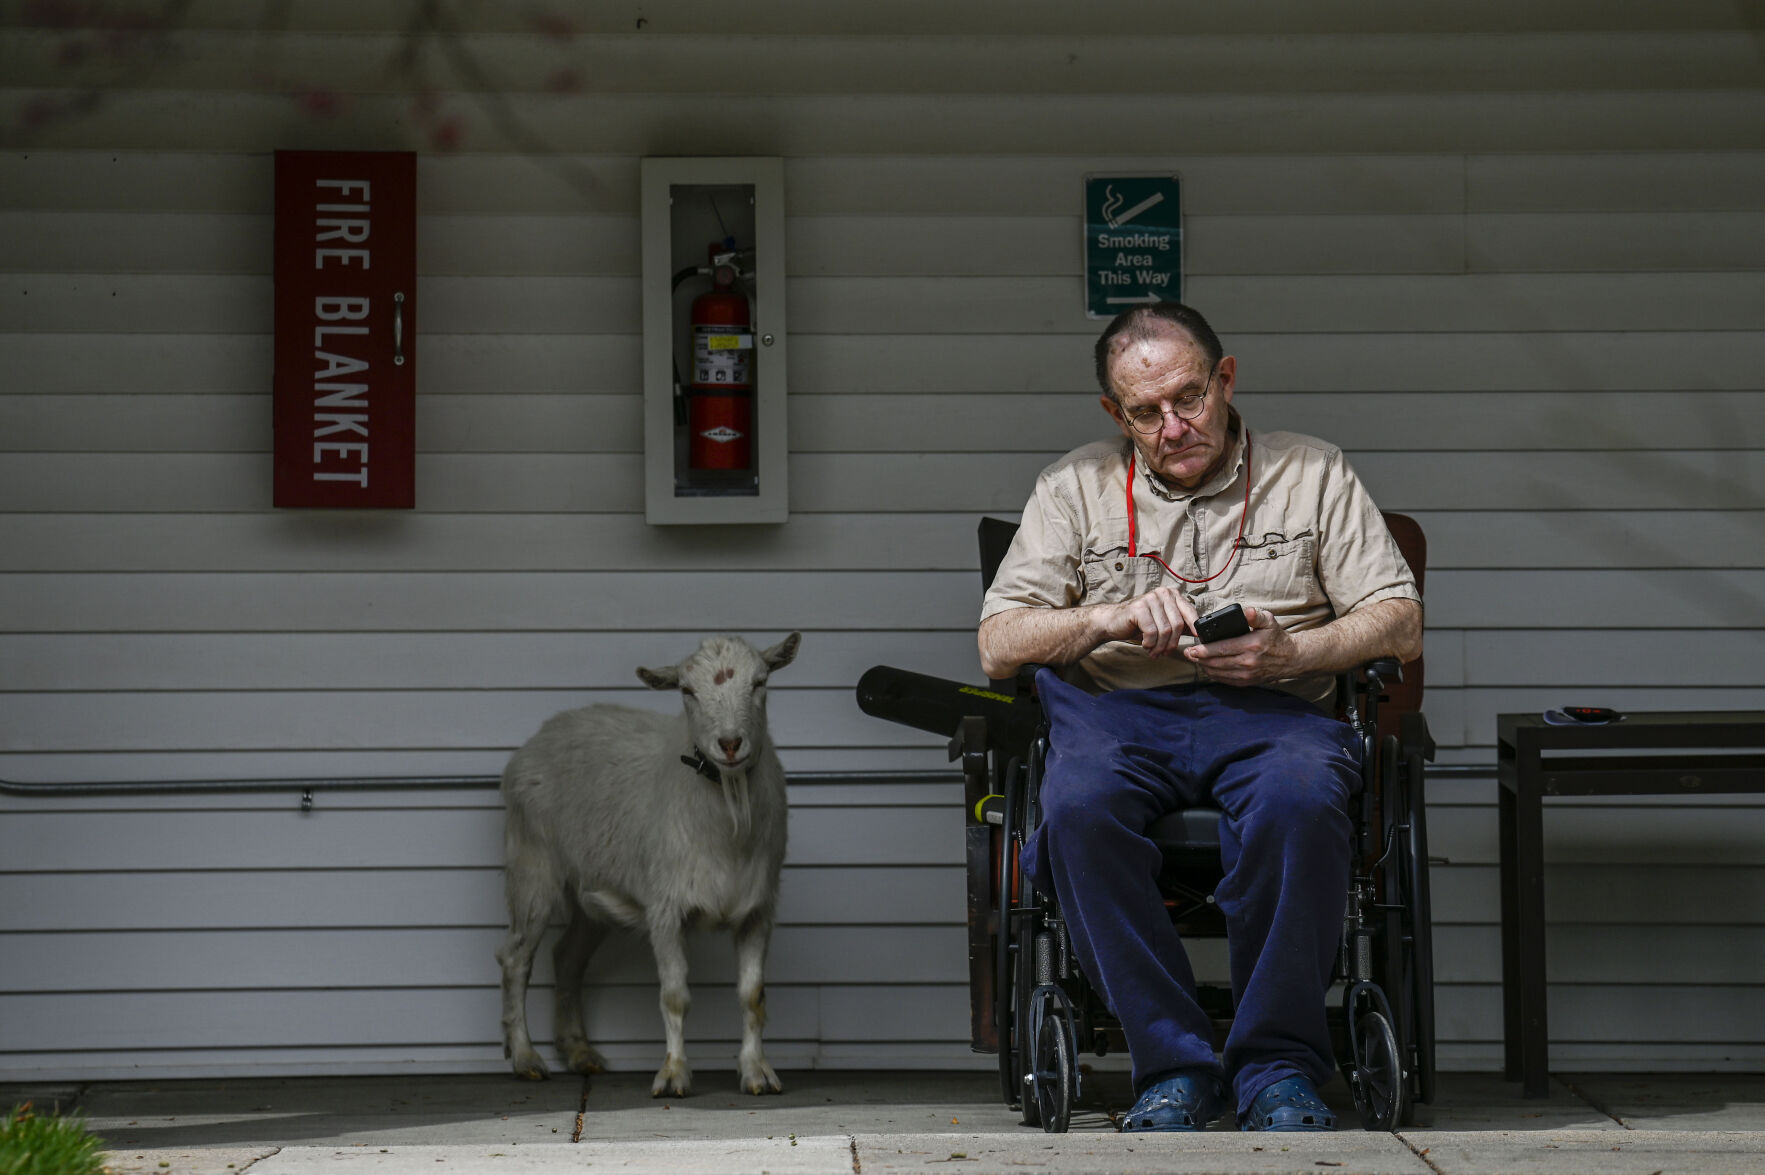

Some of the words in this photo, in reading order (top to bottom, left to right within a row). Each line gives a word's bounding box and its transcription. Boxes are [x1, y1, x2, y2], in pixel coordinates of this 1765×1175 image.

[316, 179, 371, 270] FIRE
[1098, 233, 1170, 250] Smoking
[1115, 252, 1152, 266] Area
[1098, 271, 1131, 285] This
[1136, 270, 1170, 287] Way
[313, 296, 370, 488] BLANKET
